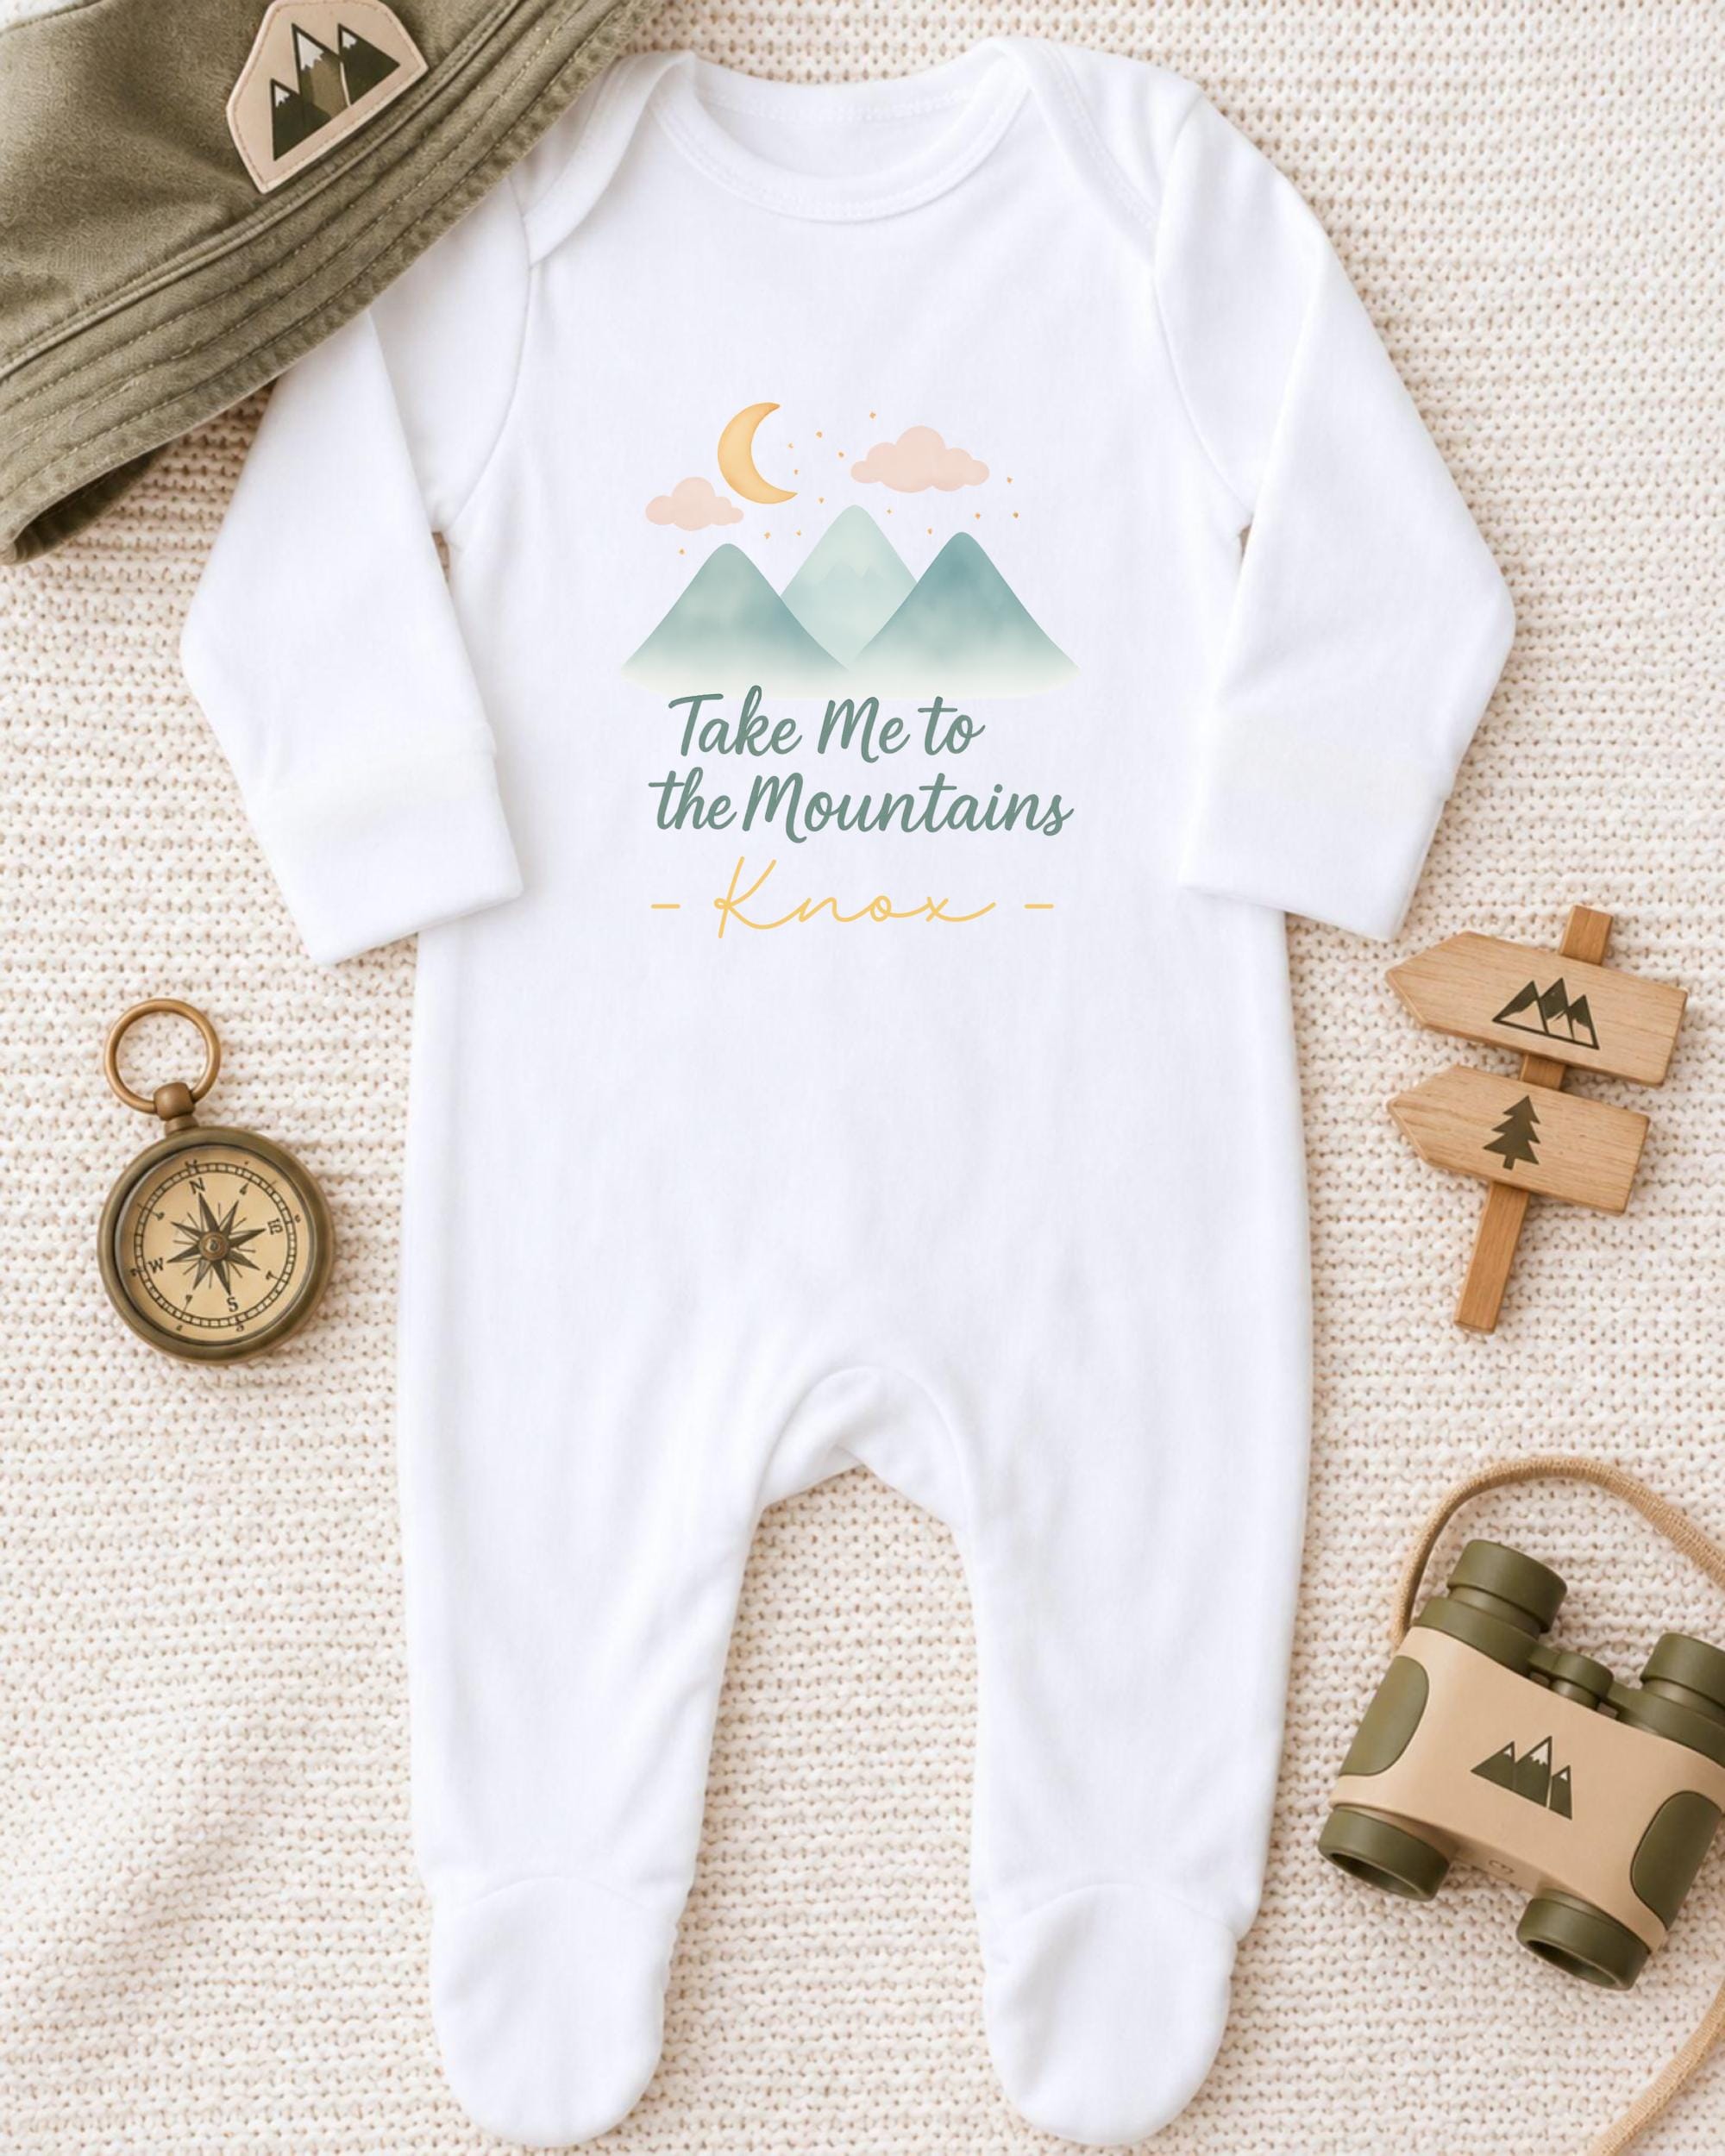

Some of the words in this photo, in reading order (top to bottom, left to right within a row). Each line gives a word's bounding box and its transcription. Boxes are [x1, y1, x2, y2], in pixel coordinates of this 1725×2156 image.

[668, 685, 803, 757] Take
[817, 696, 911, 763] Me
[917, 696, 986, 756] to
[648, 766, 737, 830] the
[742, 772, 1075, 843] Mountains
[713, 856, 996, 939] Knox
[189, 1176, 206, 1195] N
[147, 1257, 165, 1275] W
[226, 1295, 240, 1313] S
